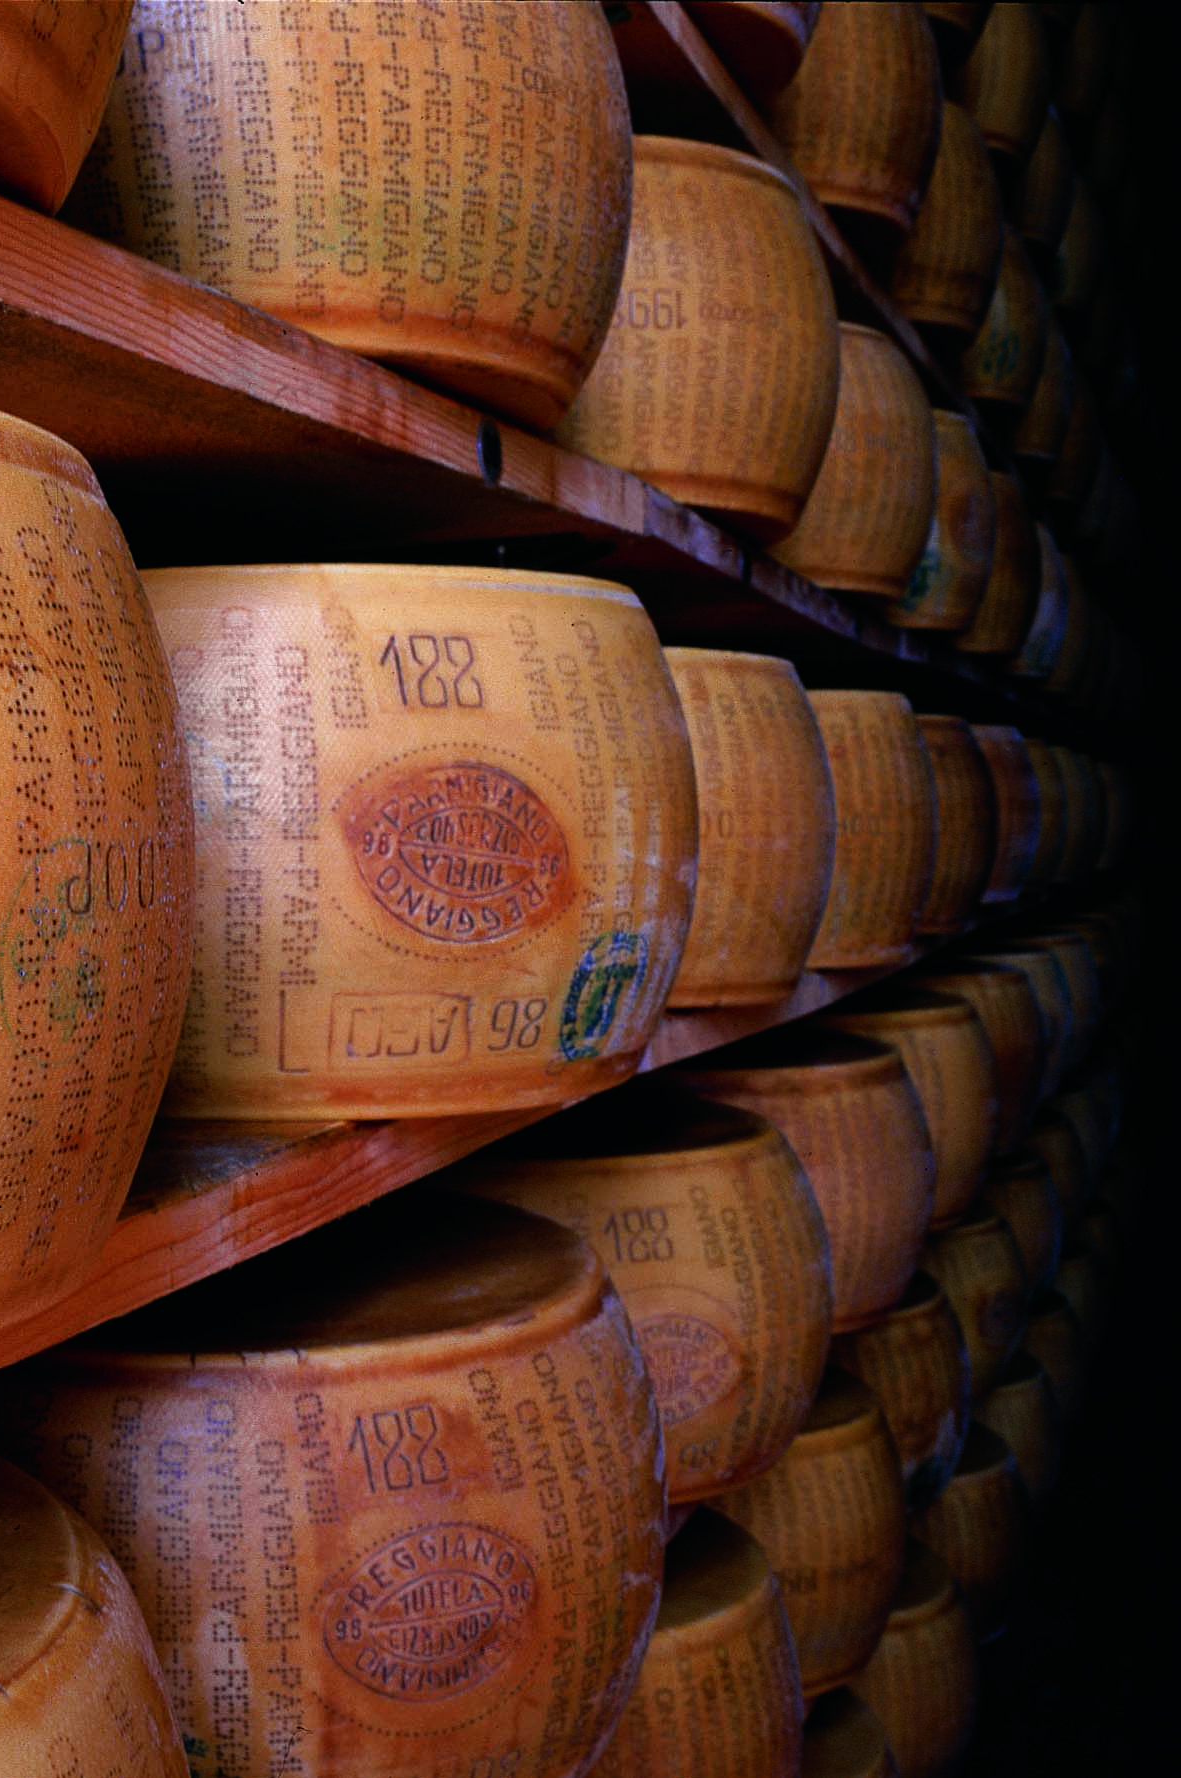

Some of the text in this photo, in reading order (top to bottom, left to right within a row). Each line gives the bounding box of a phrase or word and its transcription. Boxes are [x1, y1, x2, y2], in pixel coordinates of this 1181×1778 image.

[231, 60, 280, 274] REGGIANO
[334, 61, 369, 278] REGGIANO
[379, 63, 411, 326] PARMIGIANO
[421, 68, 453, 286] REGGIANO
[450, 75, 491, 331] PARMIGIANO
[224, 868, 262, 1057] REGGIANO
[376, 865, 546, 936] REGGIANO
[420, 853, 505, 893] TUTELA
[255, 1439, 300, 1642] REGGIANO
[347, 1533, 516, 1612] REGGIANO
[399, 1580, 485, 1617] TUTELA
